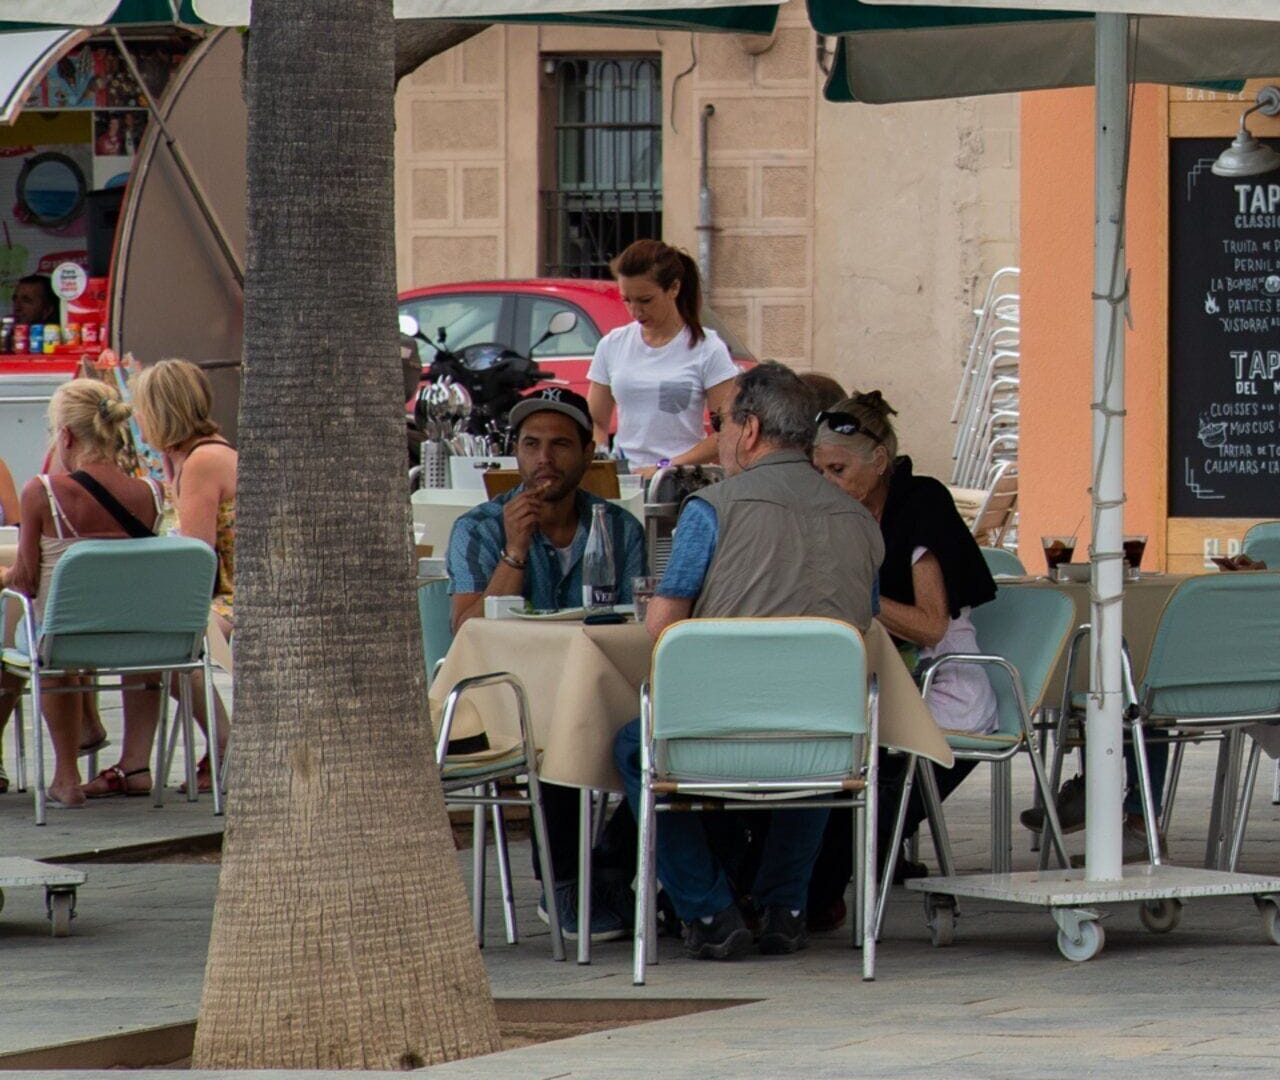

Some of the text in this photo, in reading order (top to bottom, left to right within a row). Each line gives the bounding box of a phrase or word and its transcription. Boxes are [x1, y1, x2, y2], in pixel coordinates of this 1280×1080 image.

[1222, 239, 1259, 254] TRUITA
[1234, 257, 1274, 272] PERNIL
[1210, 278, 1224, 293] LA
[1227, 299, 1272, 314] PATATES
[1235, 381, 1258, 395] DEL
[1210, 403, 1259, 417] CLOISSES
[1230, 420, 1275, 436] MUSCLOS
[1219, 444, 1253, 458] TARTAR
[1204, 459, 1260, 475] CALAMARS
